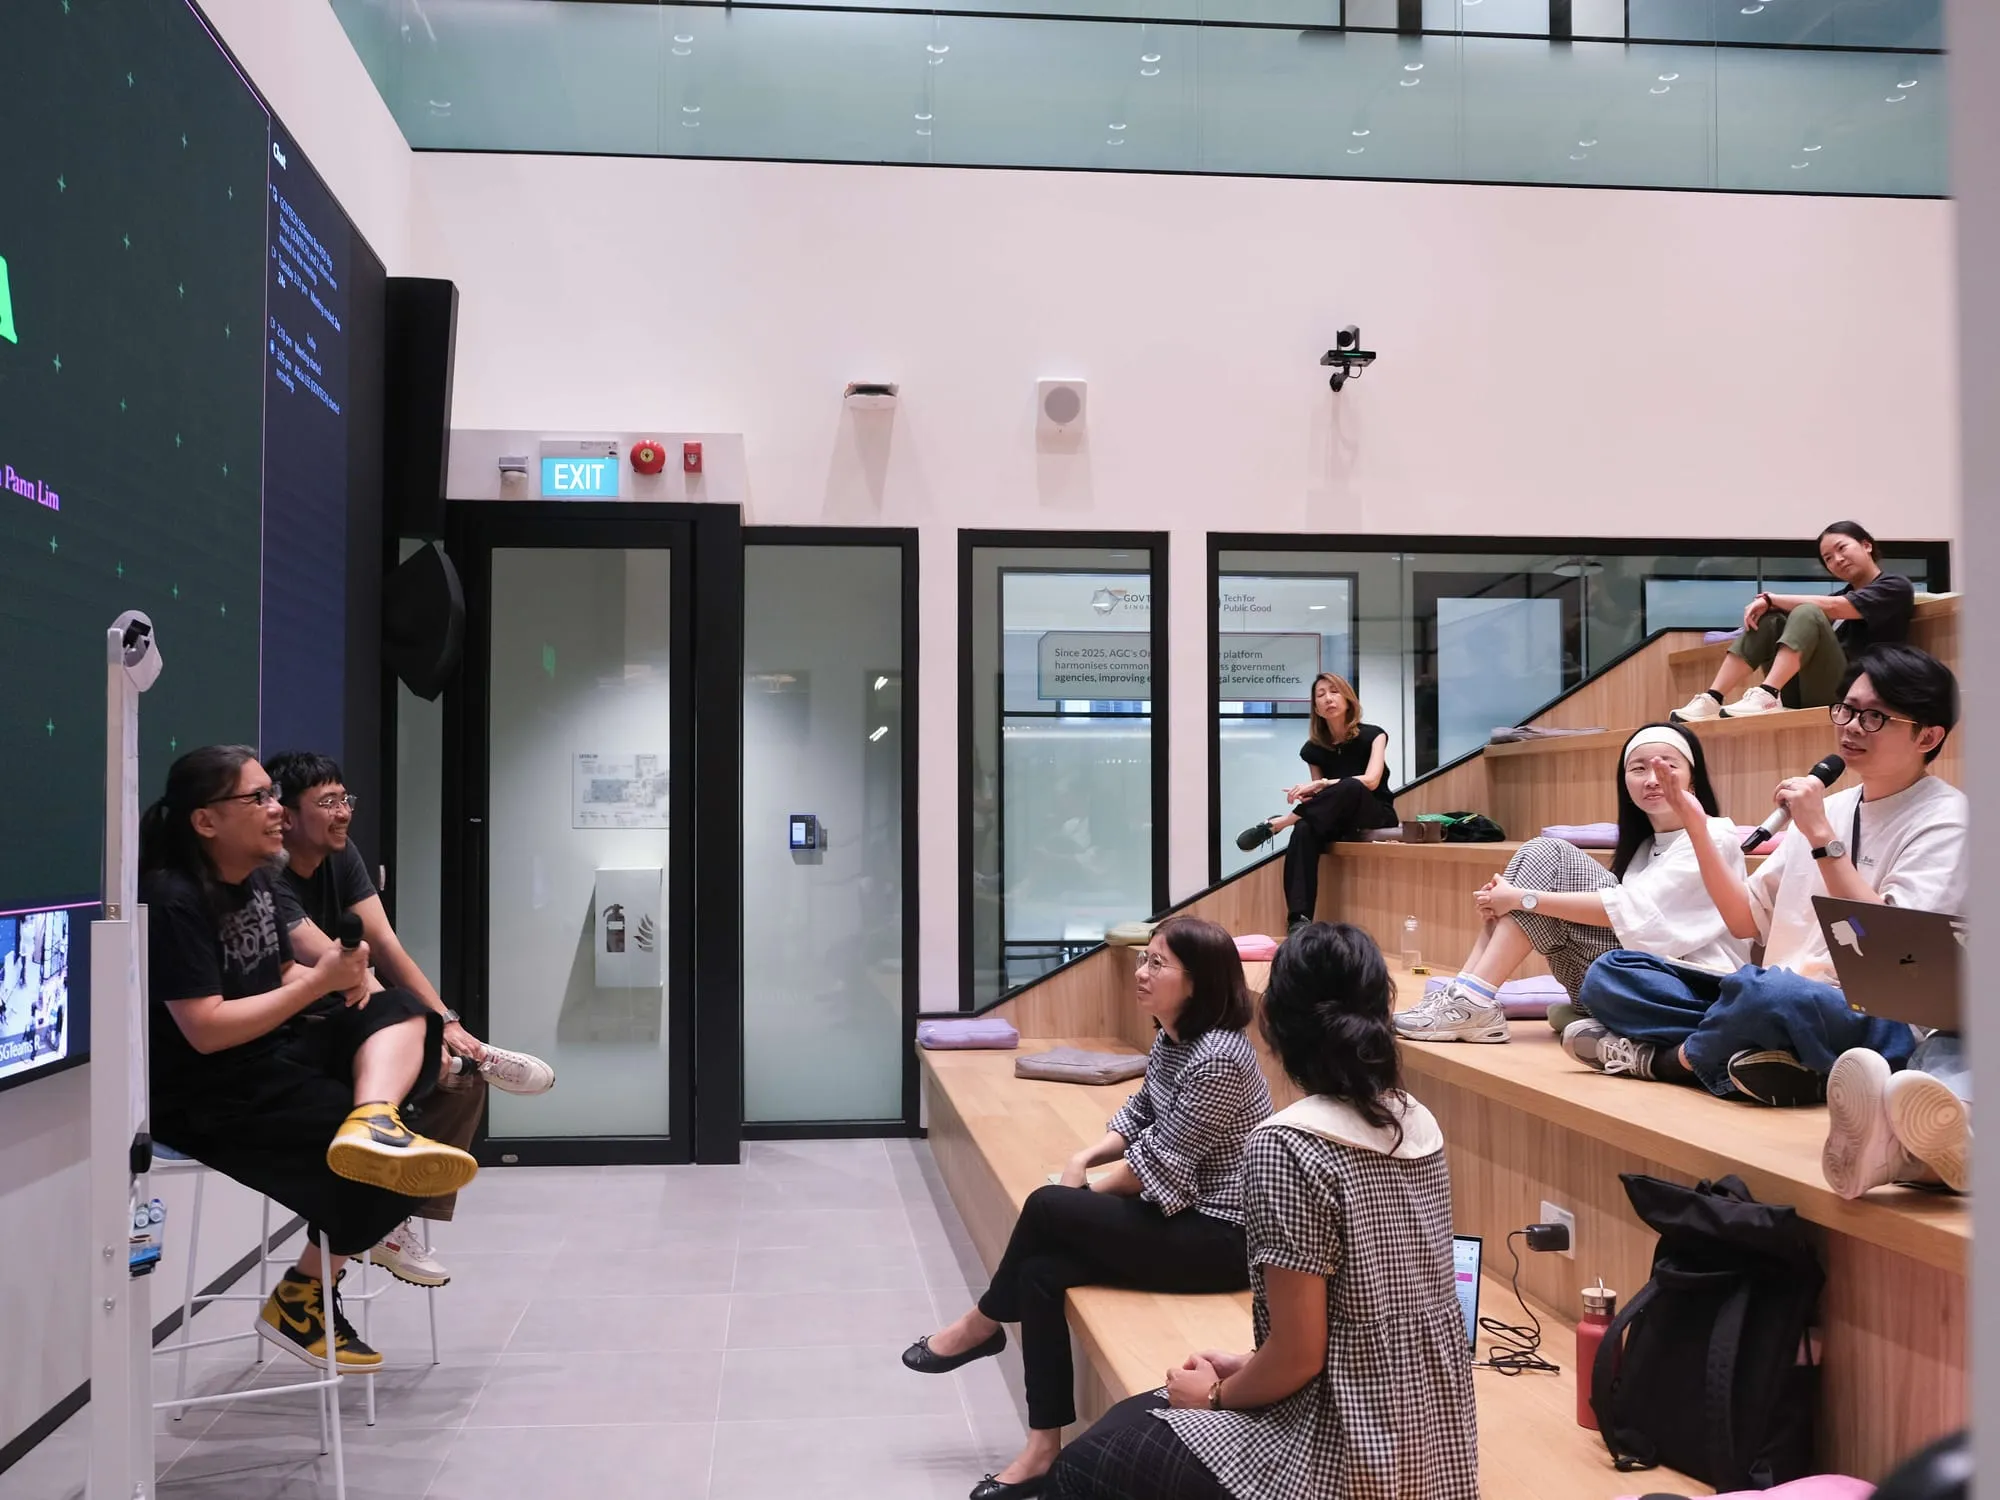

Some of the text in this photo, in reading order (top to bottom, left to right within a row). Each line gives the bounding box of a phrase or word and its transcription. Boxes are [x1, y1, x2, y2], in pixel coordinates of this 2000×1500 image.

[273, 142, 286, 170] Chat
[554, 463, 605, 490] EXIT
[5, 464, 35, 500] Pann
[38, 480, 59, 511] Lim
[1123, 594, 1152, 602] GOVT
[1223, 594, 1256, 602] Tech for
[1223, 604, 1272, 612] Public Good
[1055, 648, 1080, 657] Since
[1081, 649, 1108, 659] 2025,
[1109, 649, 1138, 658] AGC's
[1223, 650, 1263, 660] platform
[1055, 661, 1108, 670] harmonises
[1231, 663, 1286, 673] government
[1055, 673, 1098, 684] agencies,
[1098, 673, 1146, 684] improving
[1231, 675, 1265, 684] service
[1265, 674, 1302, 684] officers.
